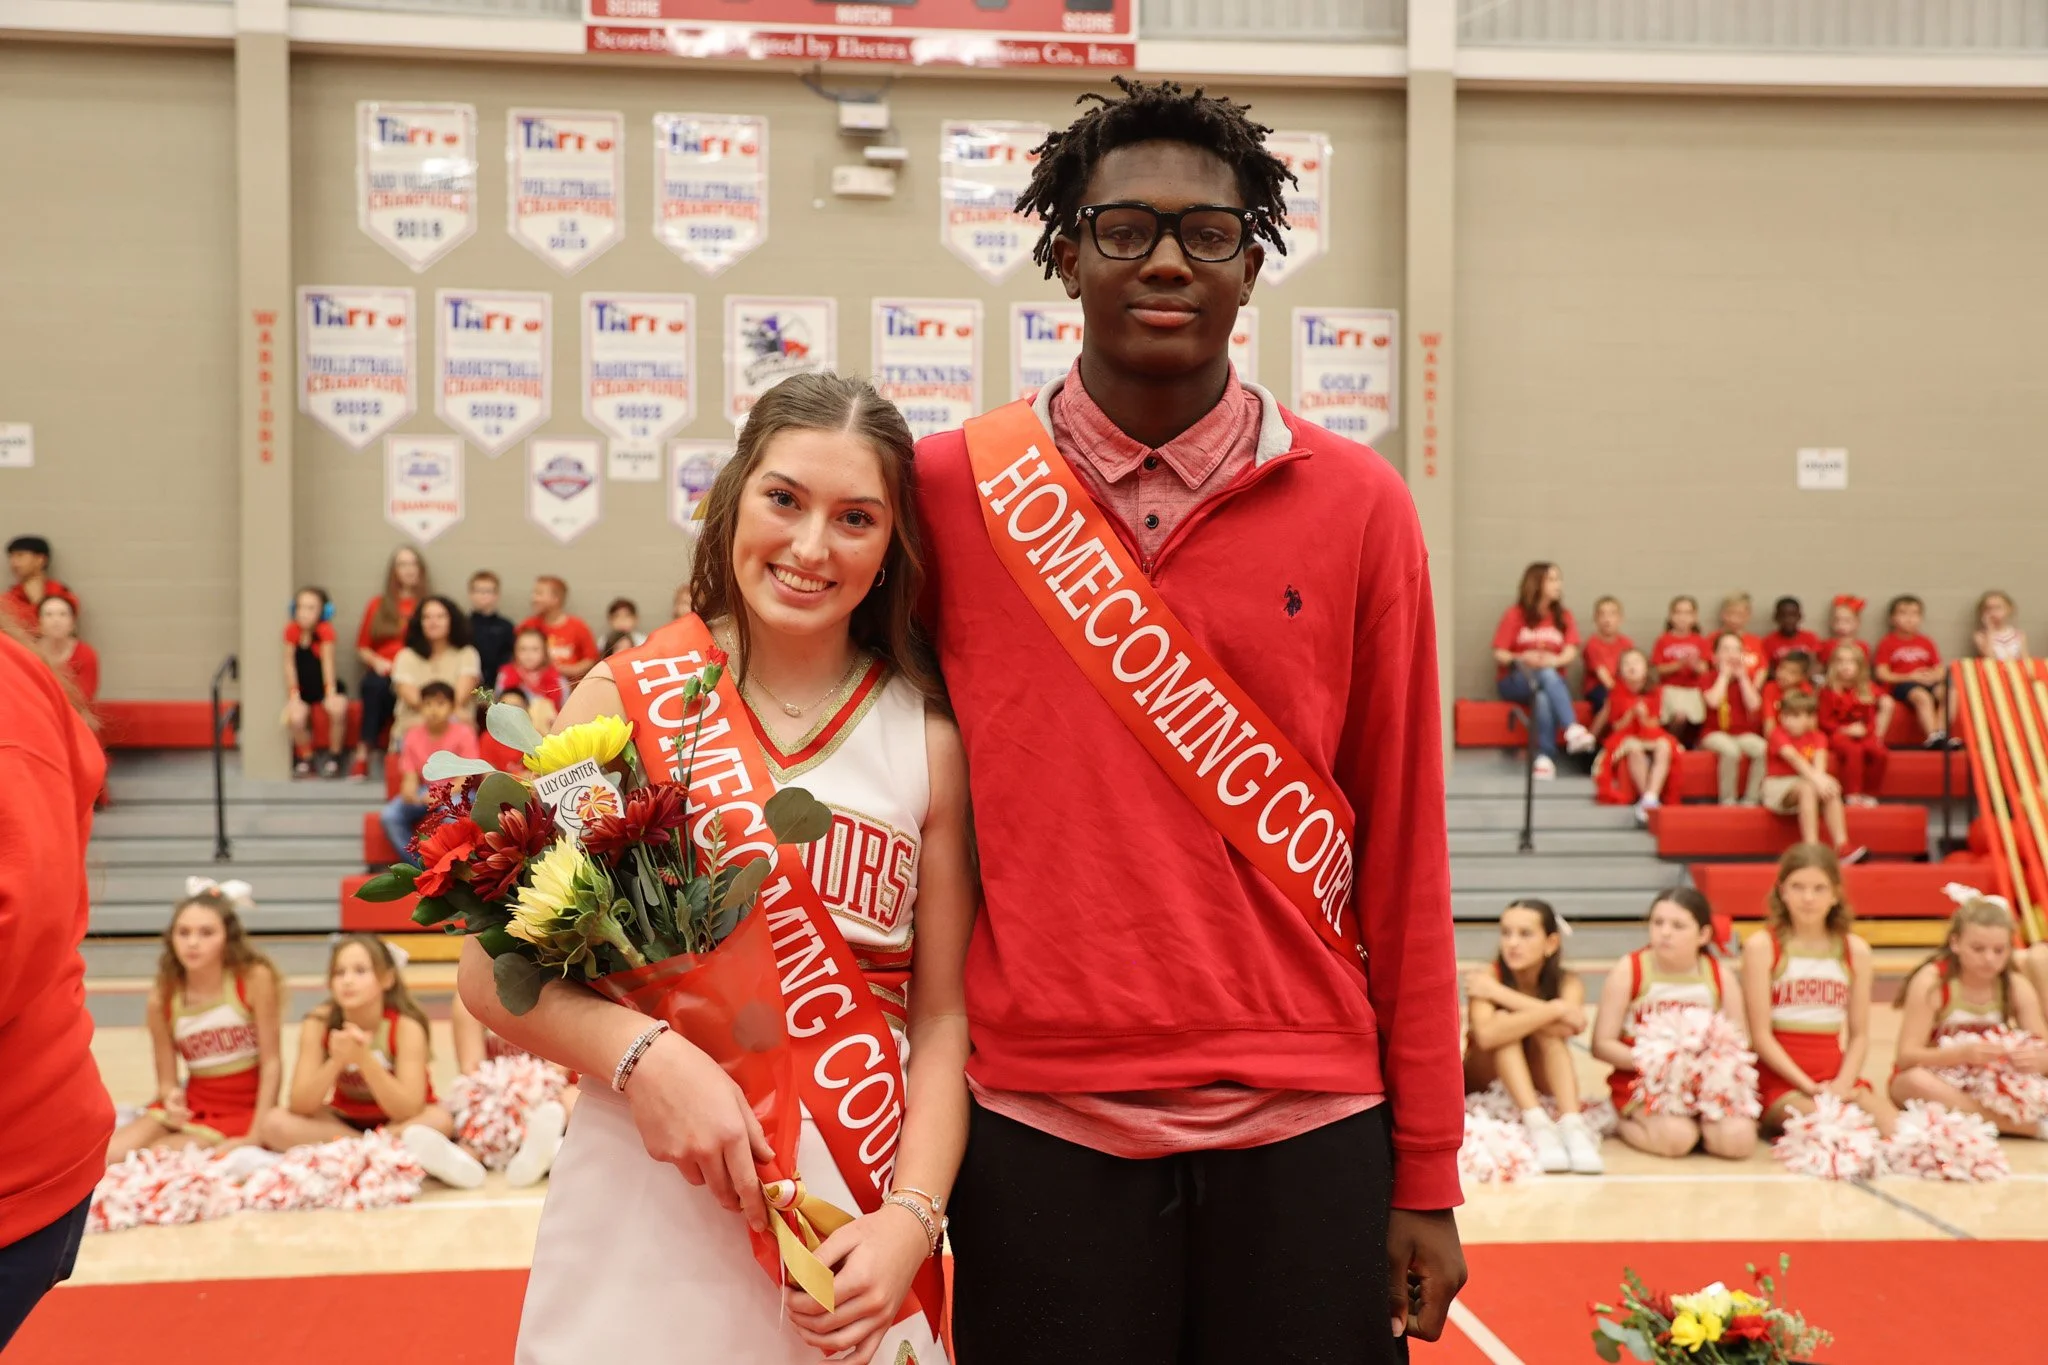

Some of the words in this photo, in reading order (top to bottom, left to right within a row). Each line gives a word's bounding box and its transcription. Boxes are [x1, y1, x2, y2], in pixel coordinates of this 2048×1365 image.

[1063, 12, 1114, 32] SCORE
[883, 365, 972, 383] TENNIS
[1320, 373, 1373, 390] GOLF
[978, 444, 1282, 806] HOMECOMING
[540, 777, 559, 796] LILY
[558, 761, 598, 787] GUNTER
